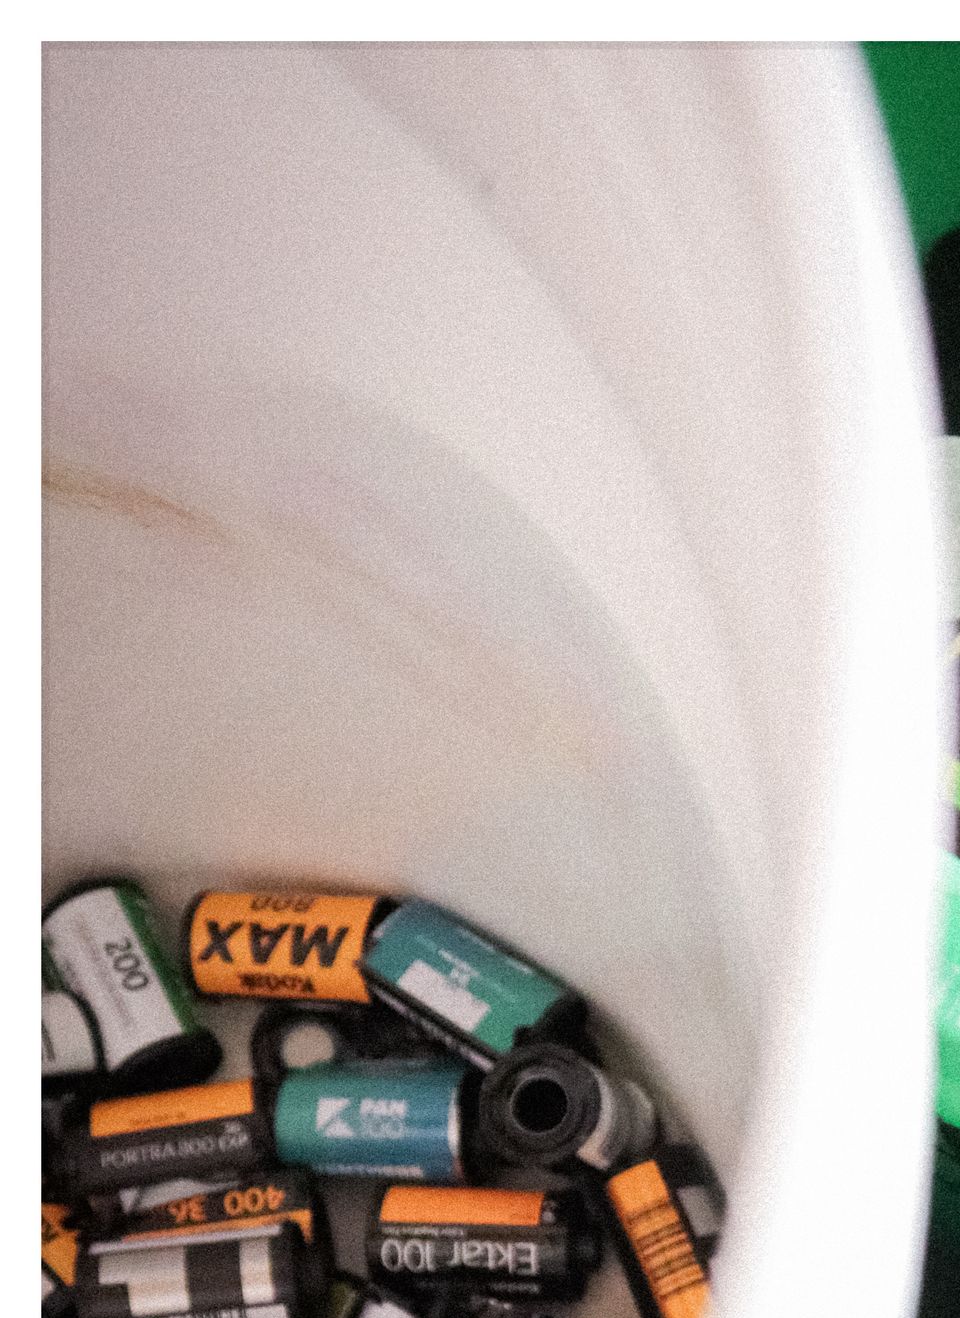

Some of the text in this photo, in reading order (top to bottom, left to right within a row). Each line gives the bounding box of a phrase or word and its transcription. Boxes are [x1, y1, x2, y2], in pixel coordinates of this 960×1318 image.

[201, 921, 350, 967] MAX
[104, 939, 149, 992] 200
[360, 1098, 408, 1117] PAN
[101, 1141, 174, 1169] PORTRA
[223, 1185, 286, 1217] 400
[379, 1238, 539, 1276] Ektar 100
